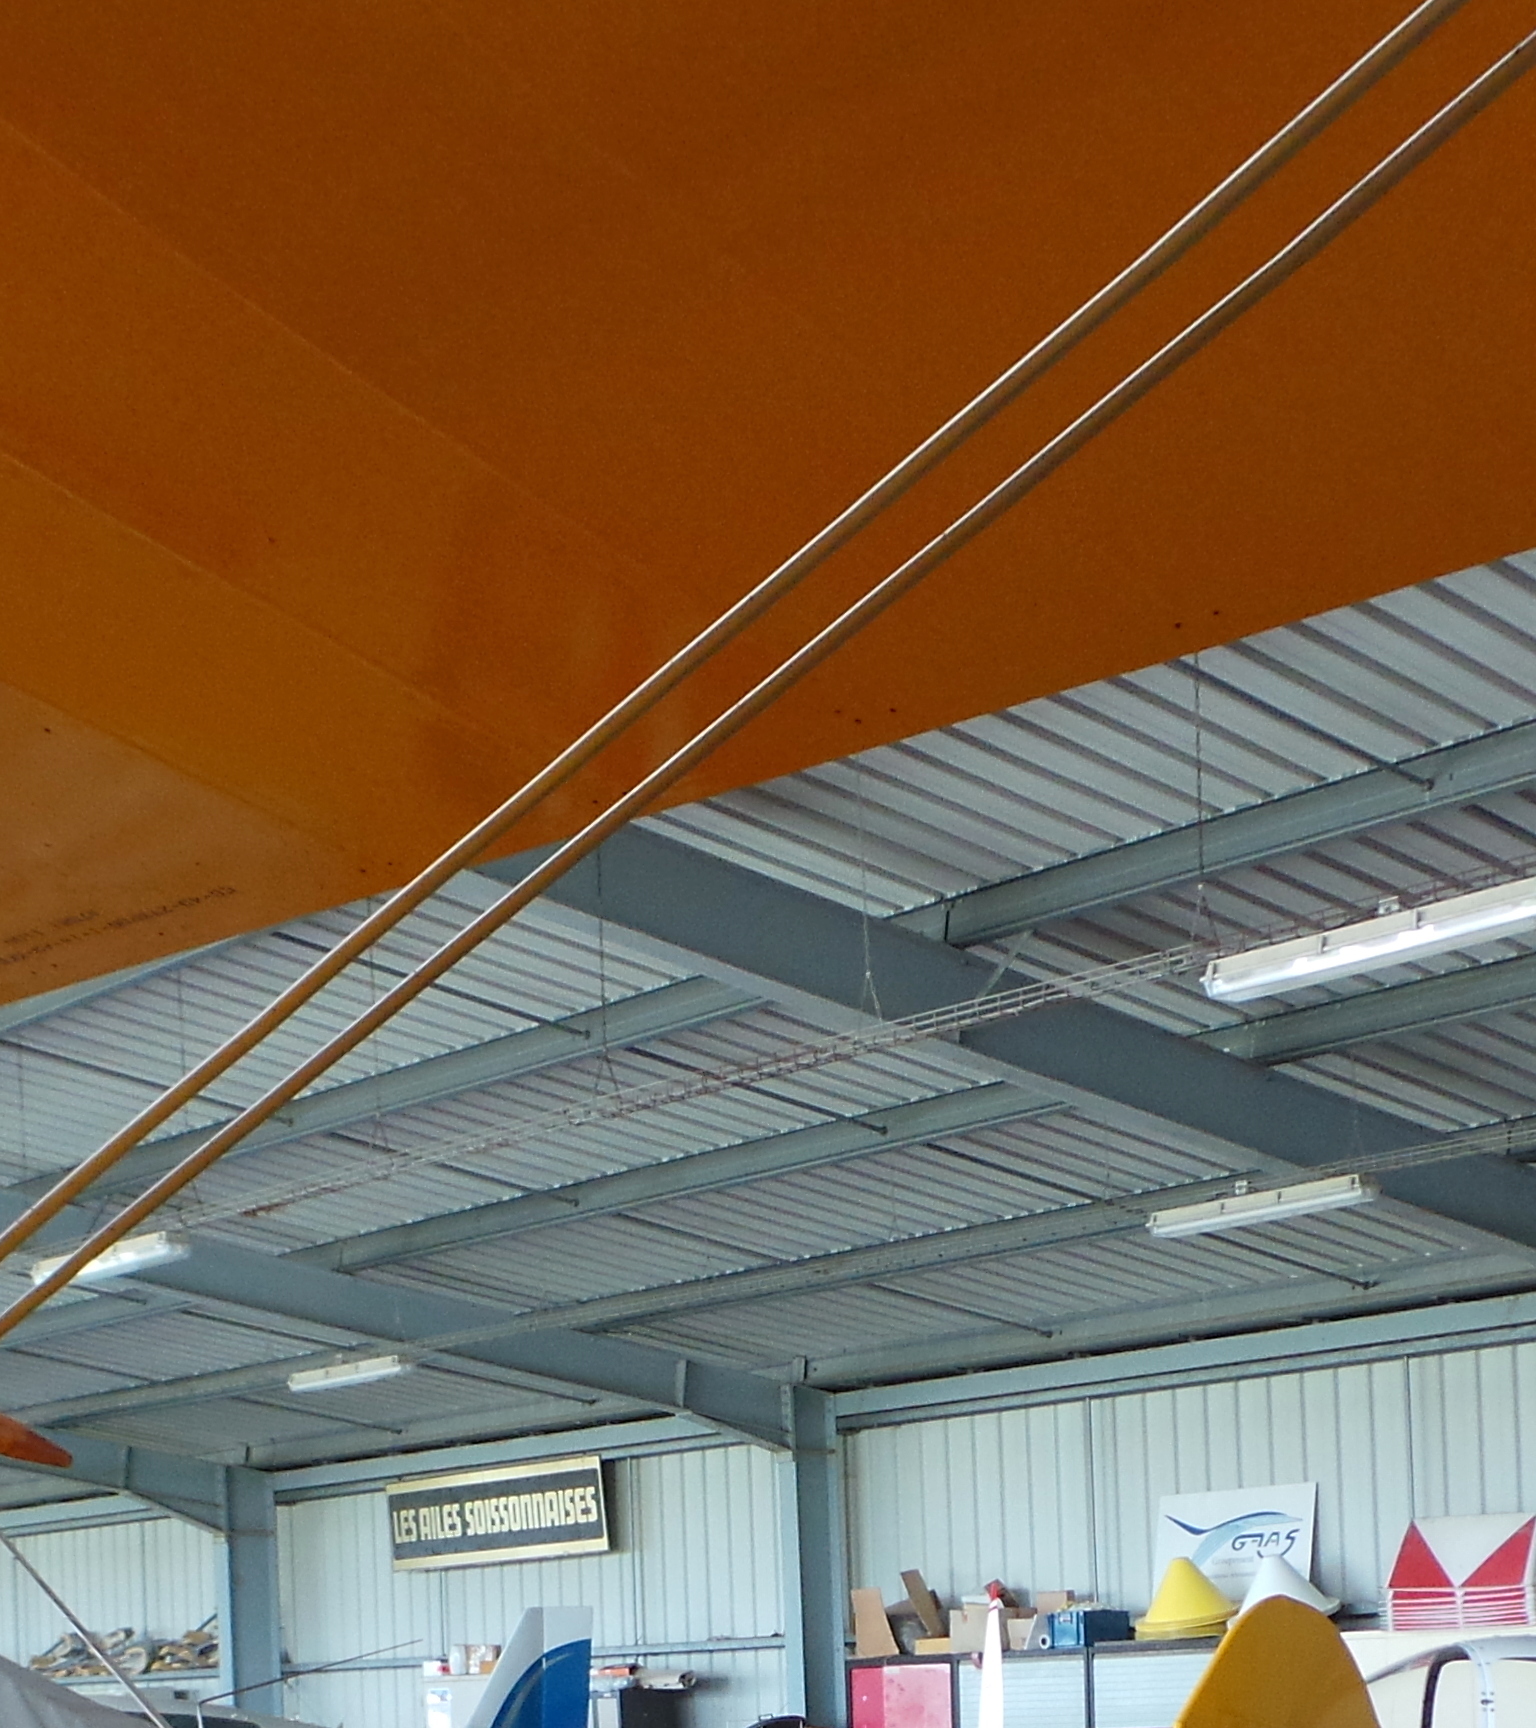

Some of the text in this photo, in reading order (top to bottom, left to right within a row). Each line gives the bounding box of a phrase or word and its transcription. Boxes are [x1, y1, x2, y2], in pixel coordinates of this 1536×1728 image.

[392, 1485, 599, 1544] LES AILES SOISSONNAISES
